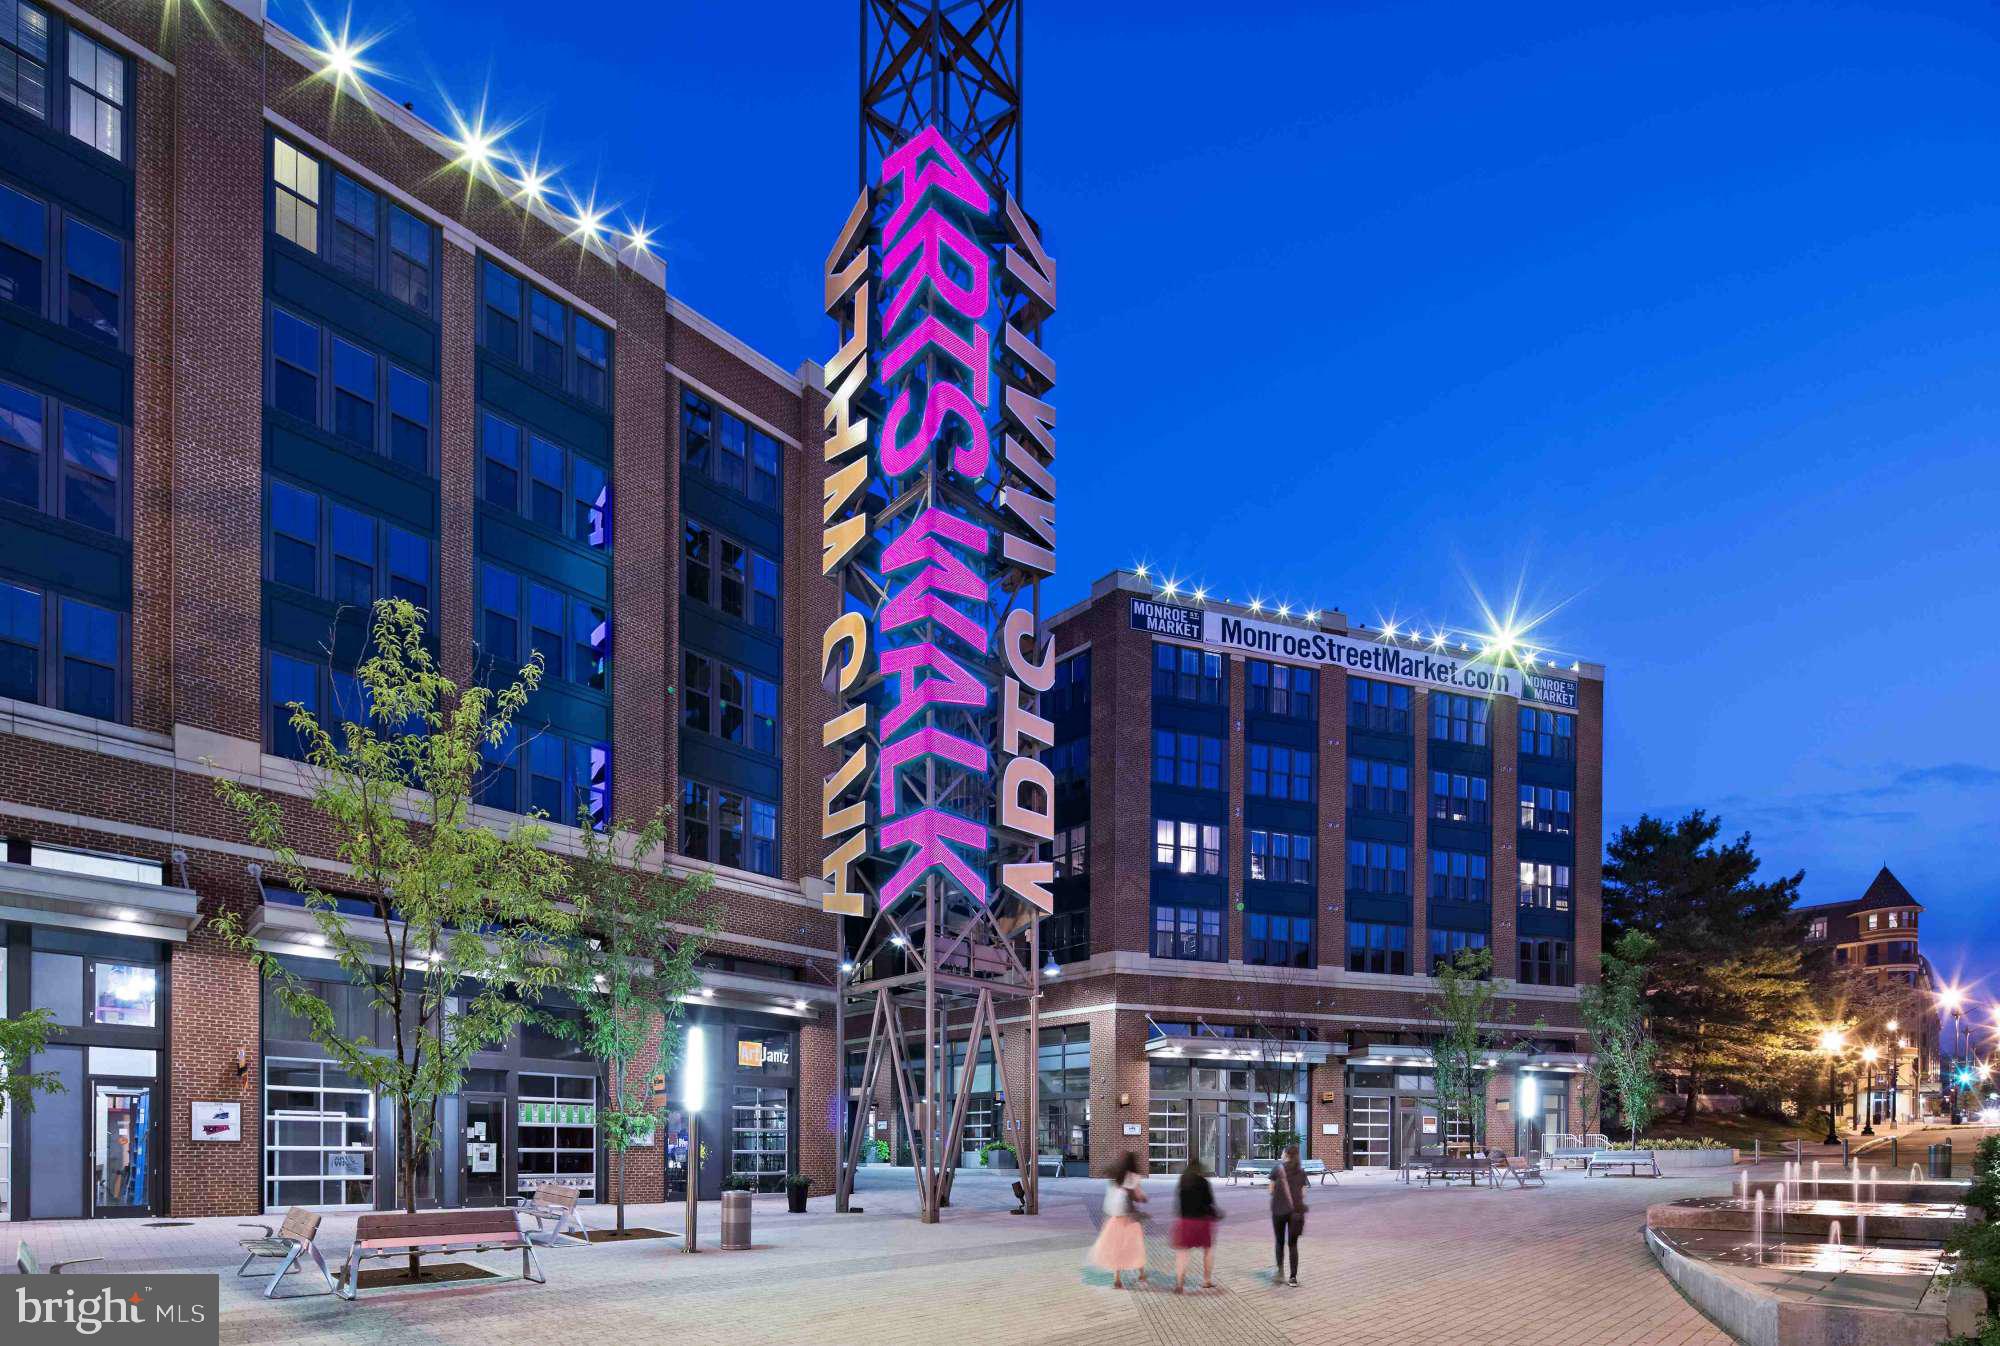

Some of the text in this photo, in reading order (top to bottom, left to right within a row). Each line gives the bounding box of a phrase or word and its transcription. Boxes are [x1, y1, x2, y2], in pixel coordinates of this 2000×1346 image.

[879, 125, 990, 913] ARTS WALK
[1133, 601, 1188, 623] MONROE
[1146, 617, 1200, 638] MARKET
[1221, 616, 1509, 693] MonroeStreetMarket.com
[1525, 675, 1566, 694] MONROE
[1534, 688, 1575, 706] MARKET
